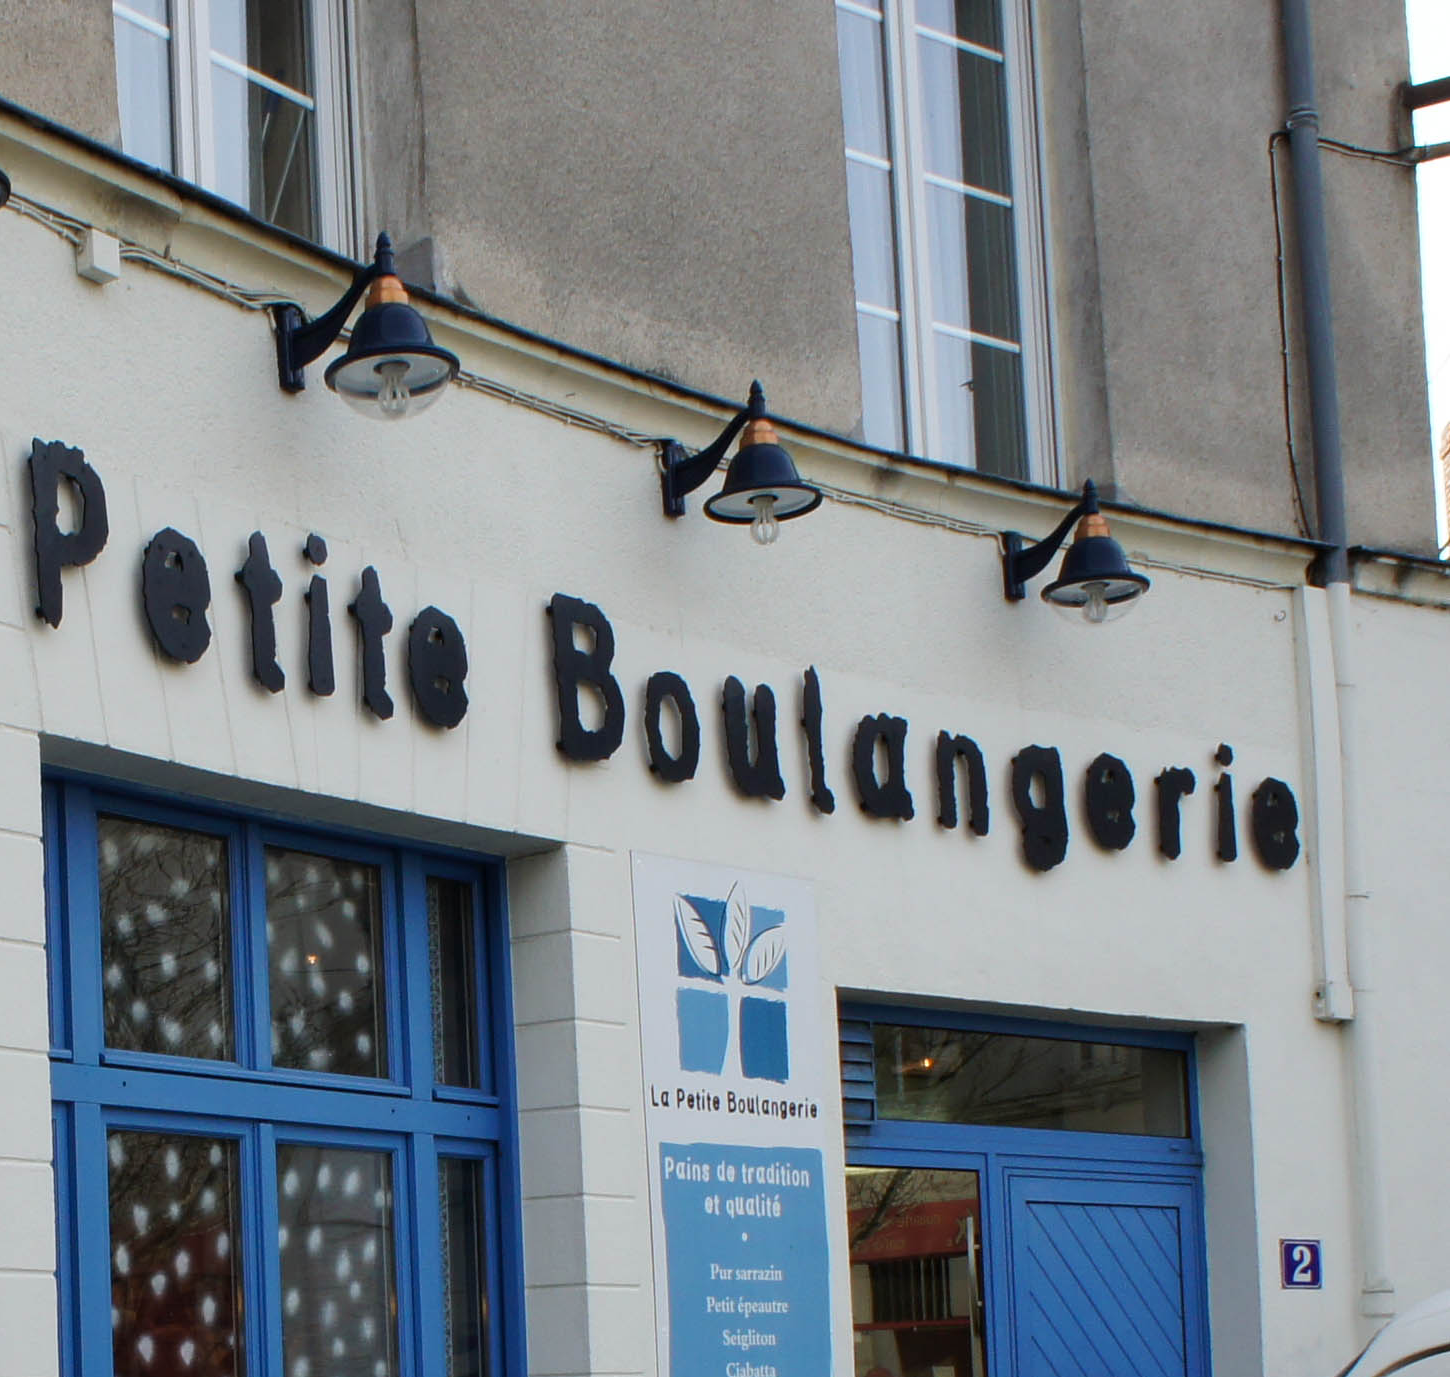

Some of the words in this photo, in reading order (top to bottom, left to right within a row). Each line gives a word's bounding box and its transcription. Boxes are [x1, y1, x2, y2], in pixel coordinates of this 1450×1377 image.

[29, 437, 469, 730] Petite
[546, 593, 1301, 872] Boulangerie
[650, 1084, 669, 1108] La
[676, 1088, 720, 1112] Petite
[727, 1091, 818, 1119] Boulangerie
[664, 1156, 710, 1183] Pains
[717, 1160, 735, 1183] de
[741, 1162, 811, 1188] tradition
[704, 1195, 720, 1216] et
[725, 1194, 781, 1219] qualité
[710, 1263, 733, 1281] Pur
[735, 1263, 783, 1282] sarrazin
[1292, 1245, 1311, 1282] 2
[706, 1296, 735, 1314] Petit
[738, 1296, 789, 1318] épeautre
